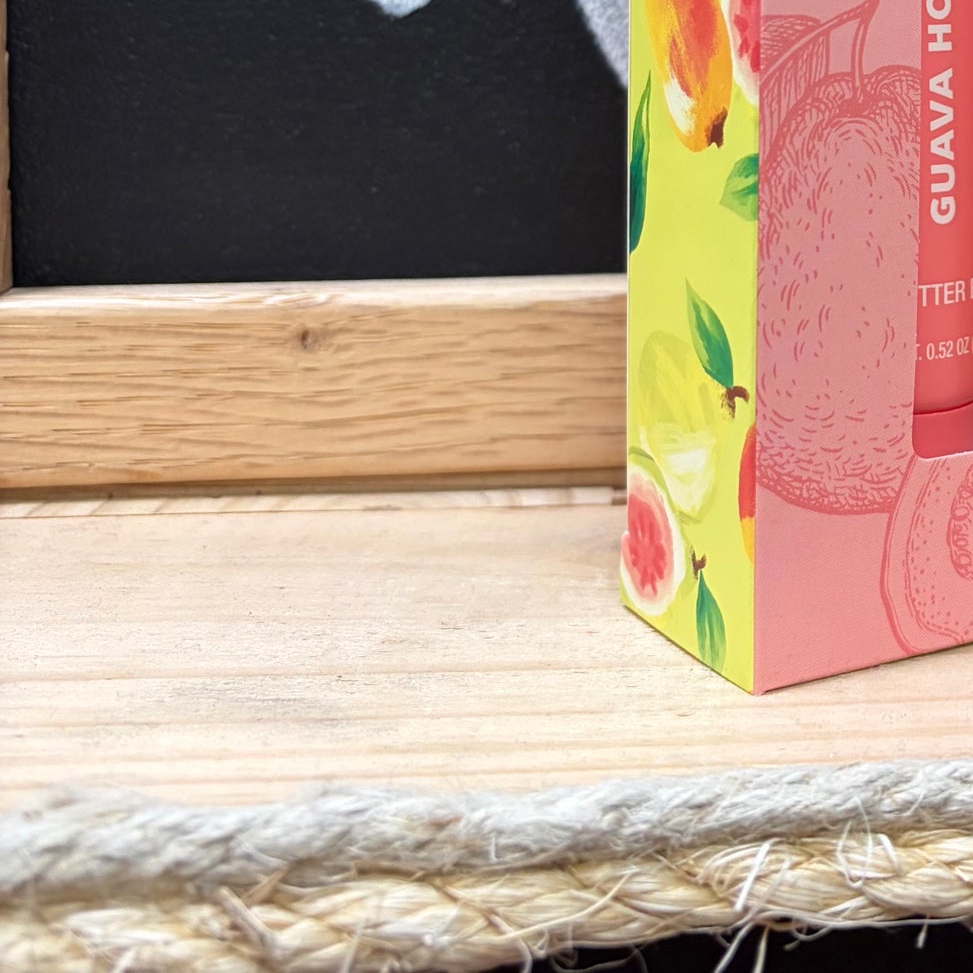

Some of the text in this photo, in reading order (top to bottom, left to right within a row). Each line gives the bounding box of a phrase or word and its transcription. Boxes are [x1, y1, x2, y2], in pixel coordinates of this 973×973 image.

[929, 67, 956, 226] GUAVA
[925, 340, 954, 361] 0.52
[956, 336, 971, 356] OZ
